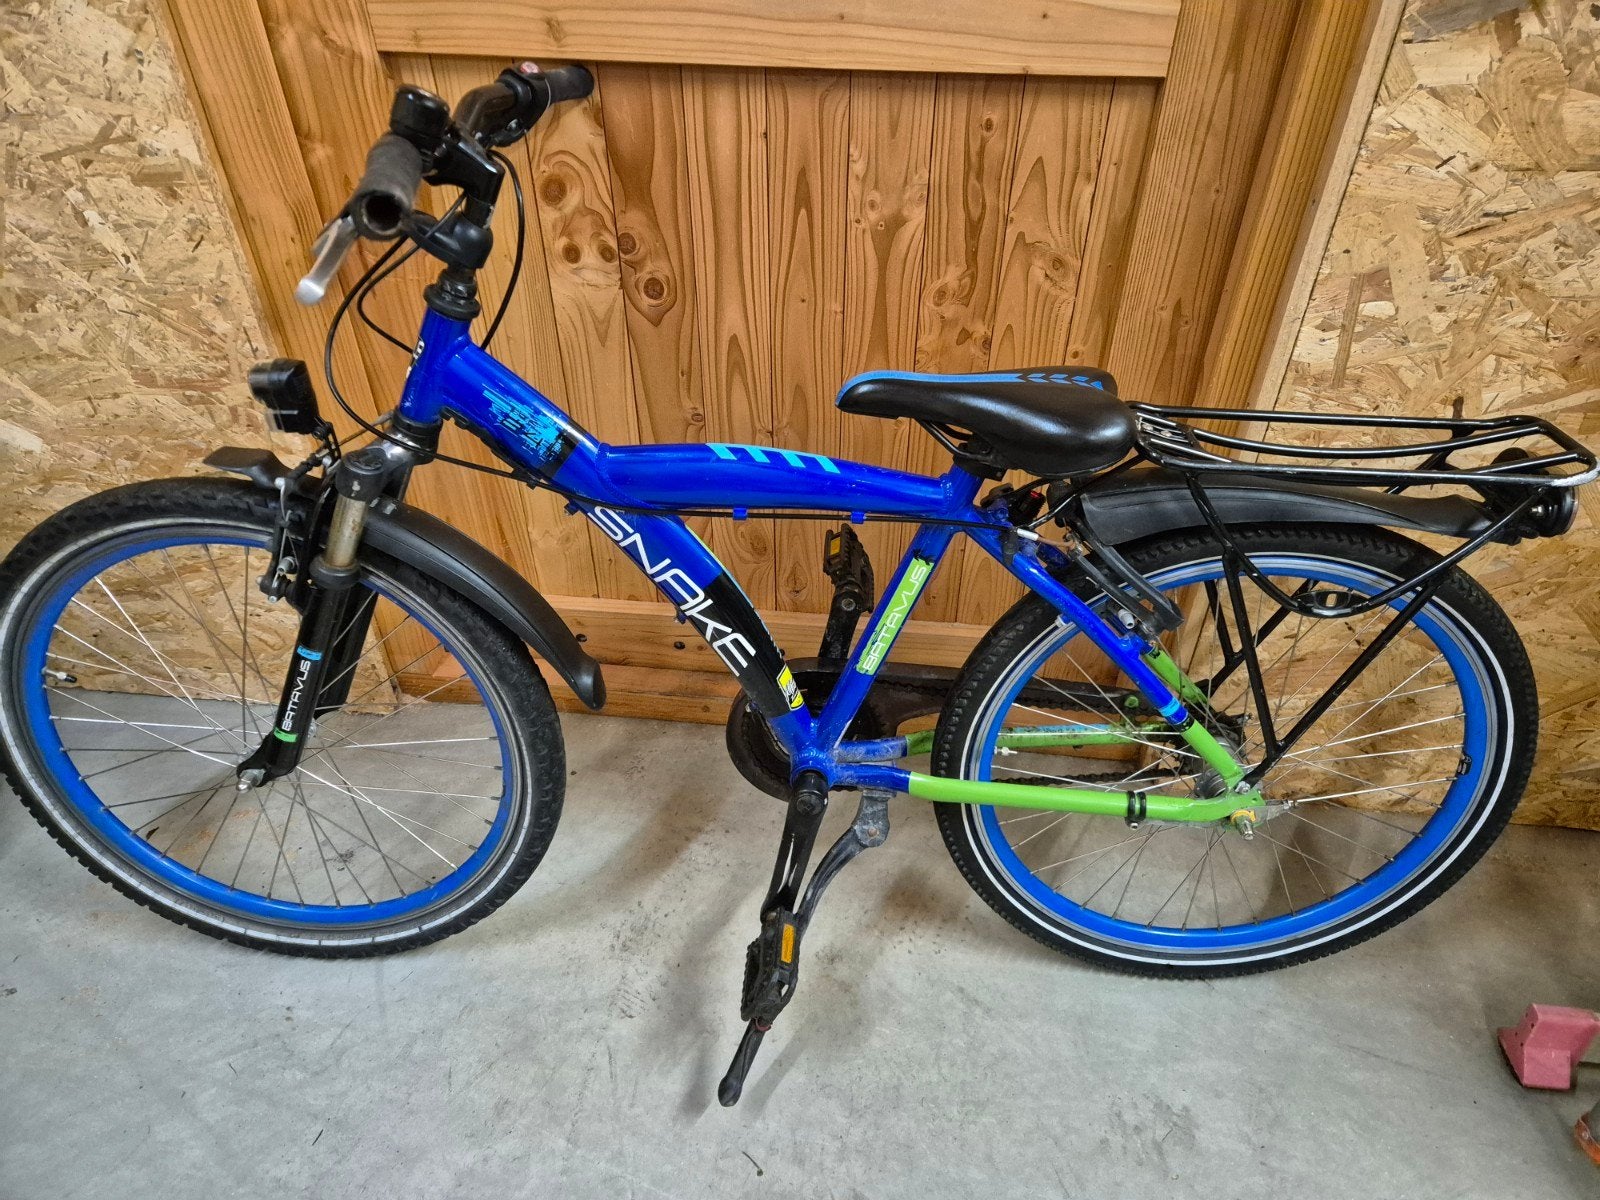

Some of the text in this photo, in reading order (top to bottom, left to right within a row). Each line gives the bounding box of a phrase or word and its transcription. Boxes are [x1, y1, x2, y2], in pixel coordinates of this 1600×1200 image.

[587, 505, 757, 677] SNAKE
[862, 564, 927, 671] BATAVUS
[281, 659, 311, 732] BATAVUS
